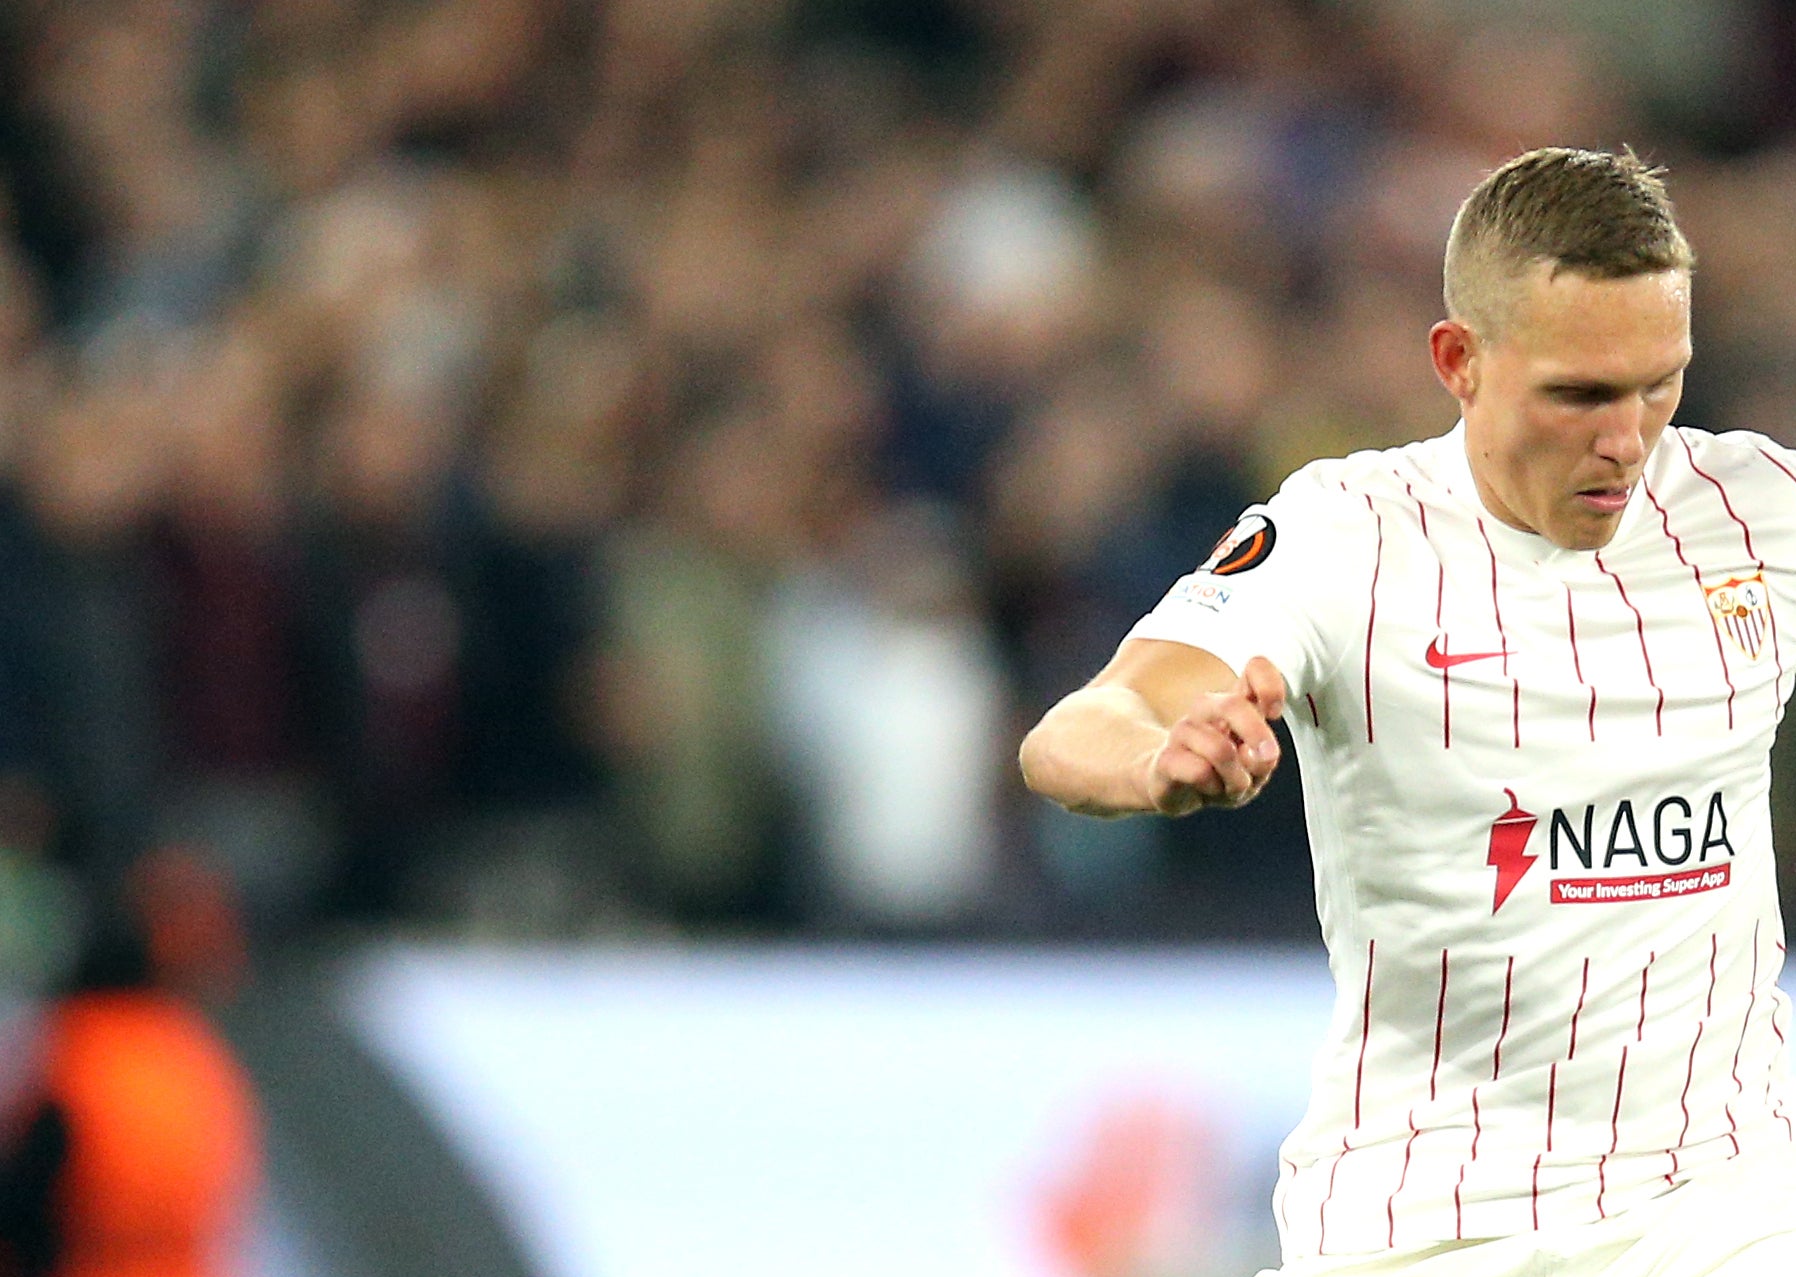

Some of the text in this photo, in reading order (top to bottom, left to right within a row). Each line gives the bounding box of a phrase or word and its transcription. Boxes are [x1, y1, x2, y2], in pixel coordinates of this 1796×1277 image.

[1550, 791, 1735, 870] NAGA
[1557, 871, 1726, 899] Your Investing Super App
